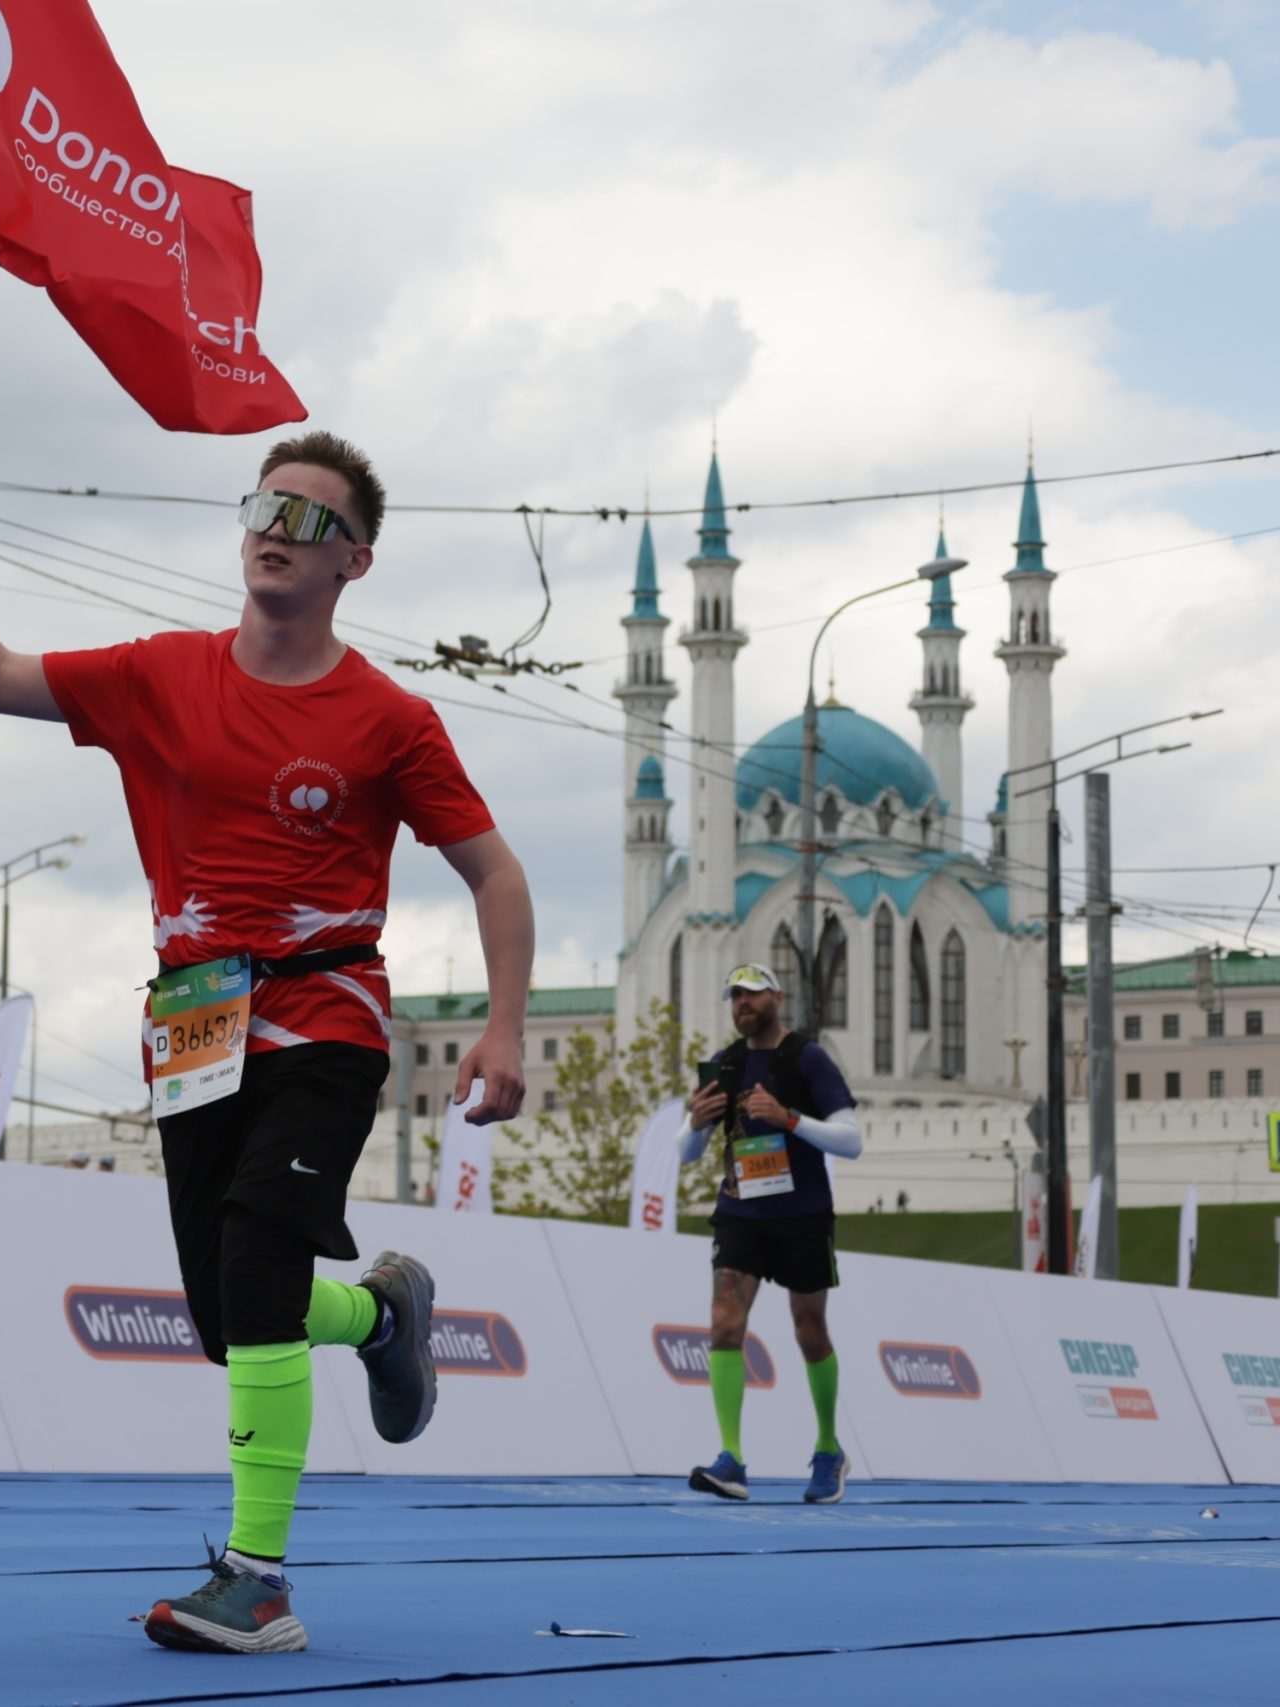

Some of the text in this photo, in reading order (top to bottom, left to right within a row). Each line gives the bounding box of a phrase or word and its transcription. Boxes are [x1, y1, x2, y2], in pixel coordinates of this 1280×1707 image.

[173, 1011, 239, 1055] 36637
[77, 1303, 193, 1346] Winline
[428, 1324, 491, 1361] nline
[660, 1338, 712, 1371] Winl
[885, 1352, 955, 1387] Winline
[1058, 1338, 1139, 1378] СИБУР
